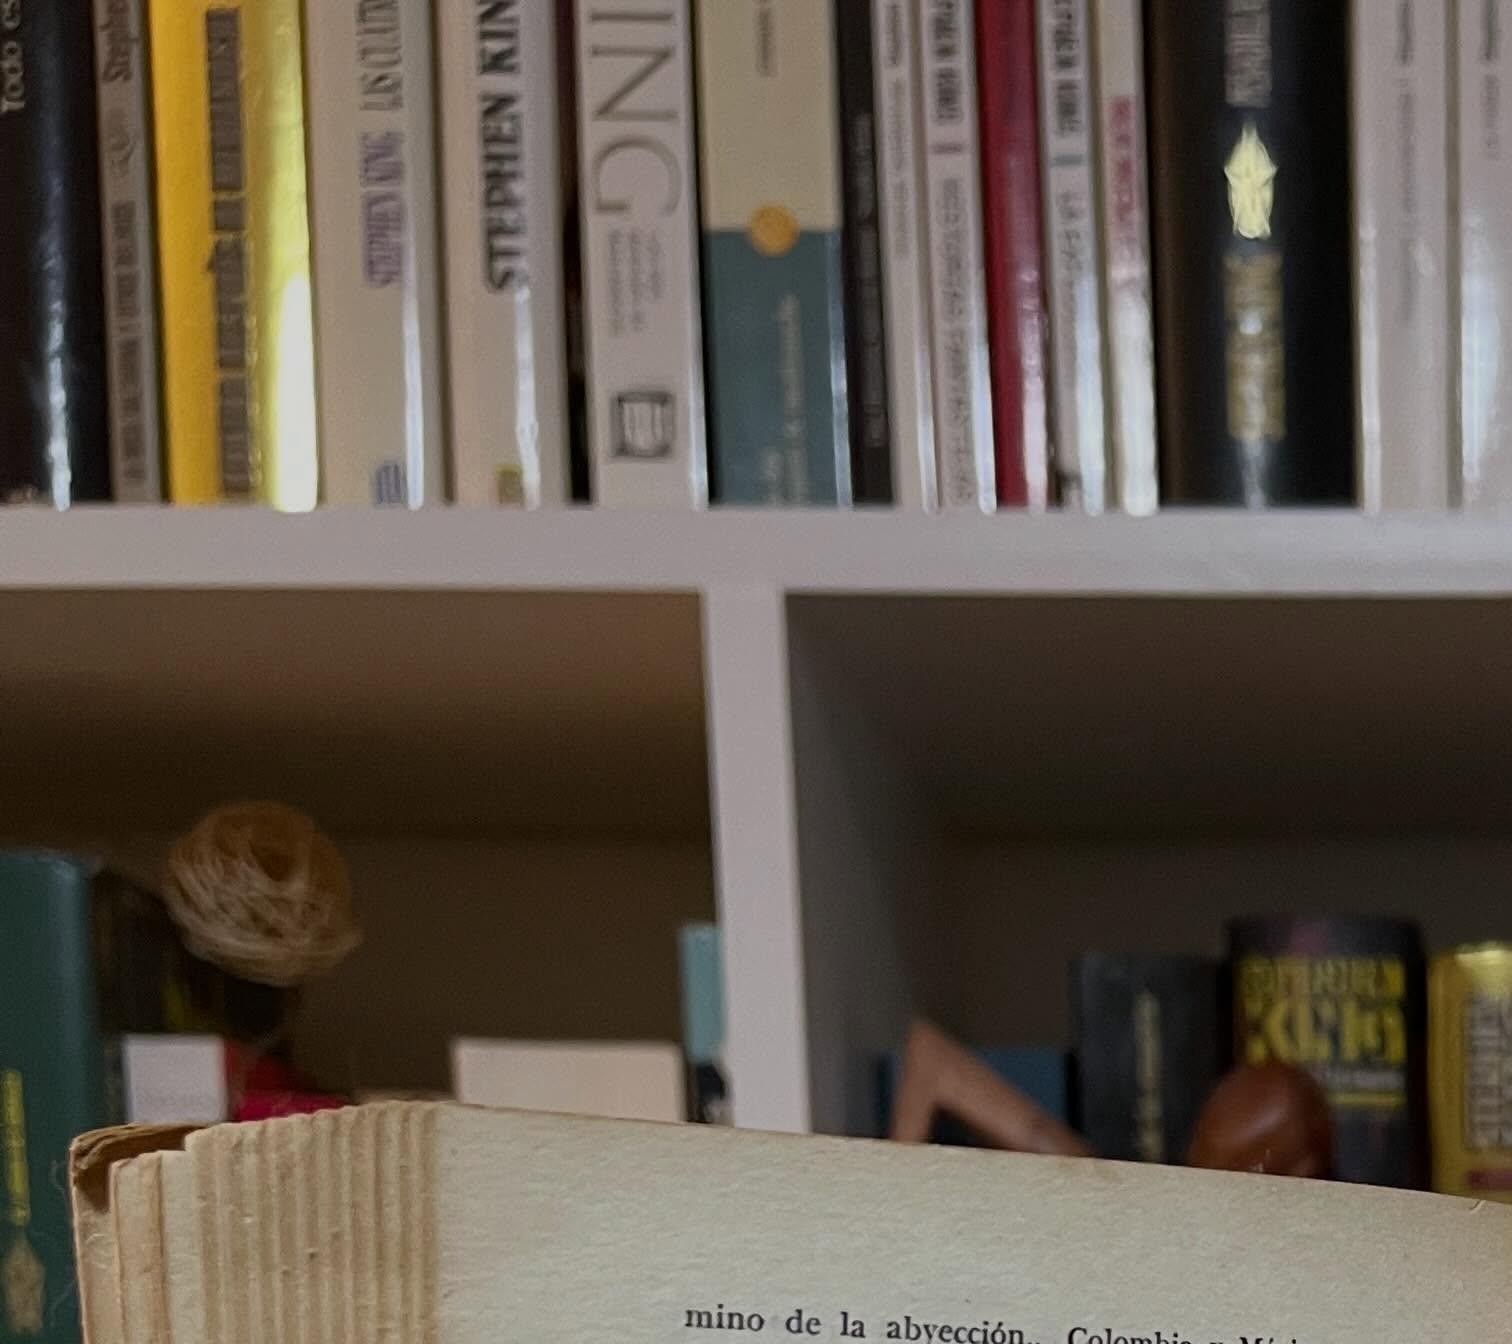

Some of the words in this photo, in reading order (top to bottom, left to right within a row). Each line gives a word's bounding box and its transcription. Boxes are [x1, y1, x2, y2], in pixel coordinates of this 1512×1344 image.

[1, 41, 26, 114] Todo
[360, 131, 402, 190] KING
[478, 91, 531, 292] STEPHEN
[361, 195, 404, 288] STEPHEN
[684, 1303, 766, 1333] mino
[784, 1308, 822, 1337] de
[839, 1310, 867, 1339] la
